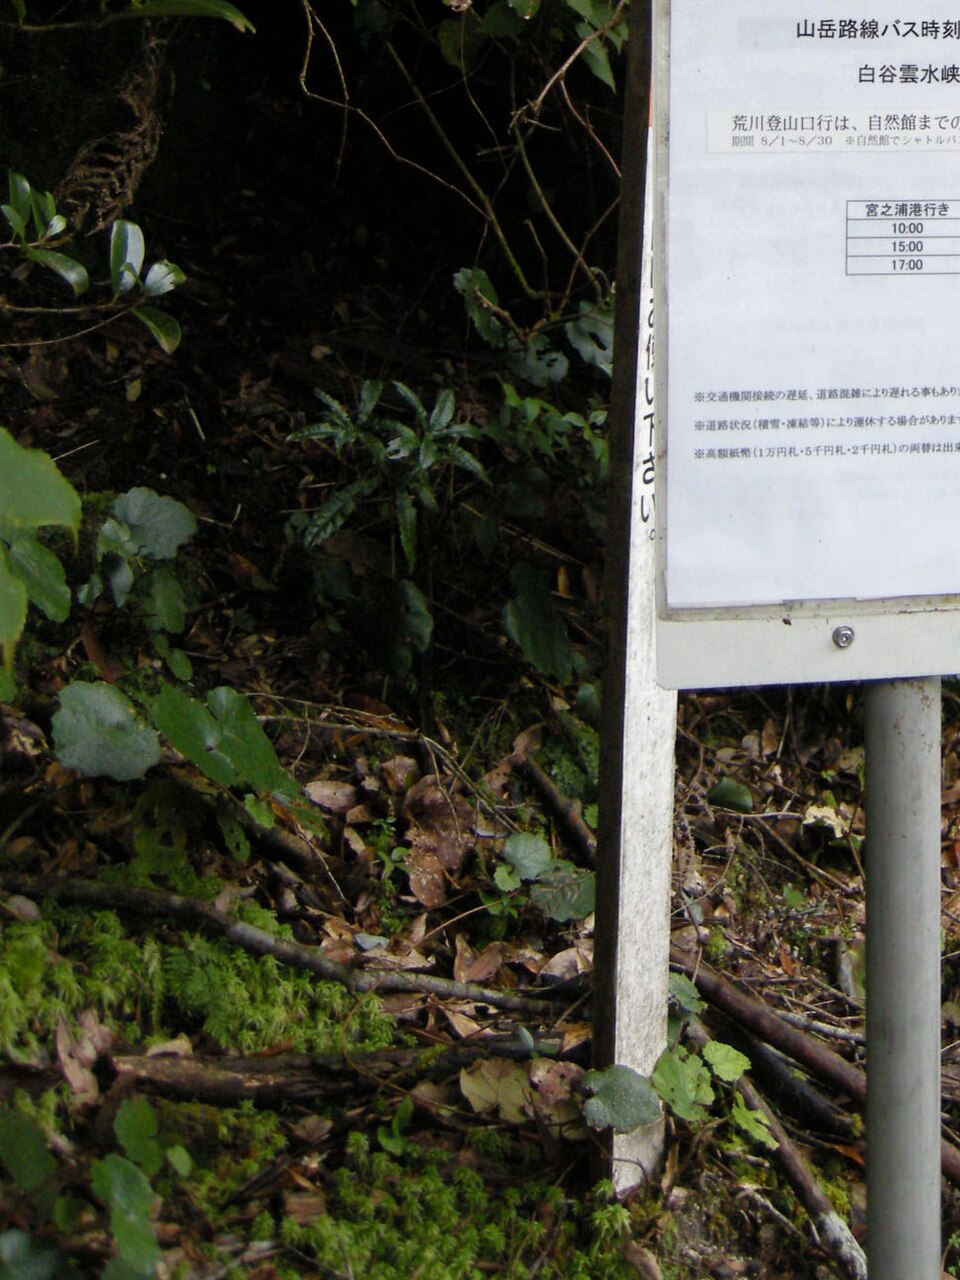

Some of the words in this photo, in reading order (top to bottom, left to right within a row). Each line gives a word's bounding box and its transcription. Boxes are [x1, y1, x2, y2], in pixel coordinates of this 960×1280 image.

[865, 202, 950, 217] 宮之浦港行き
[892, 222, 924, 234] 10:00
[892, 240, 924, 252] 15:00
[892, 258, 924, 270] 17:00
